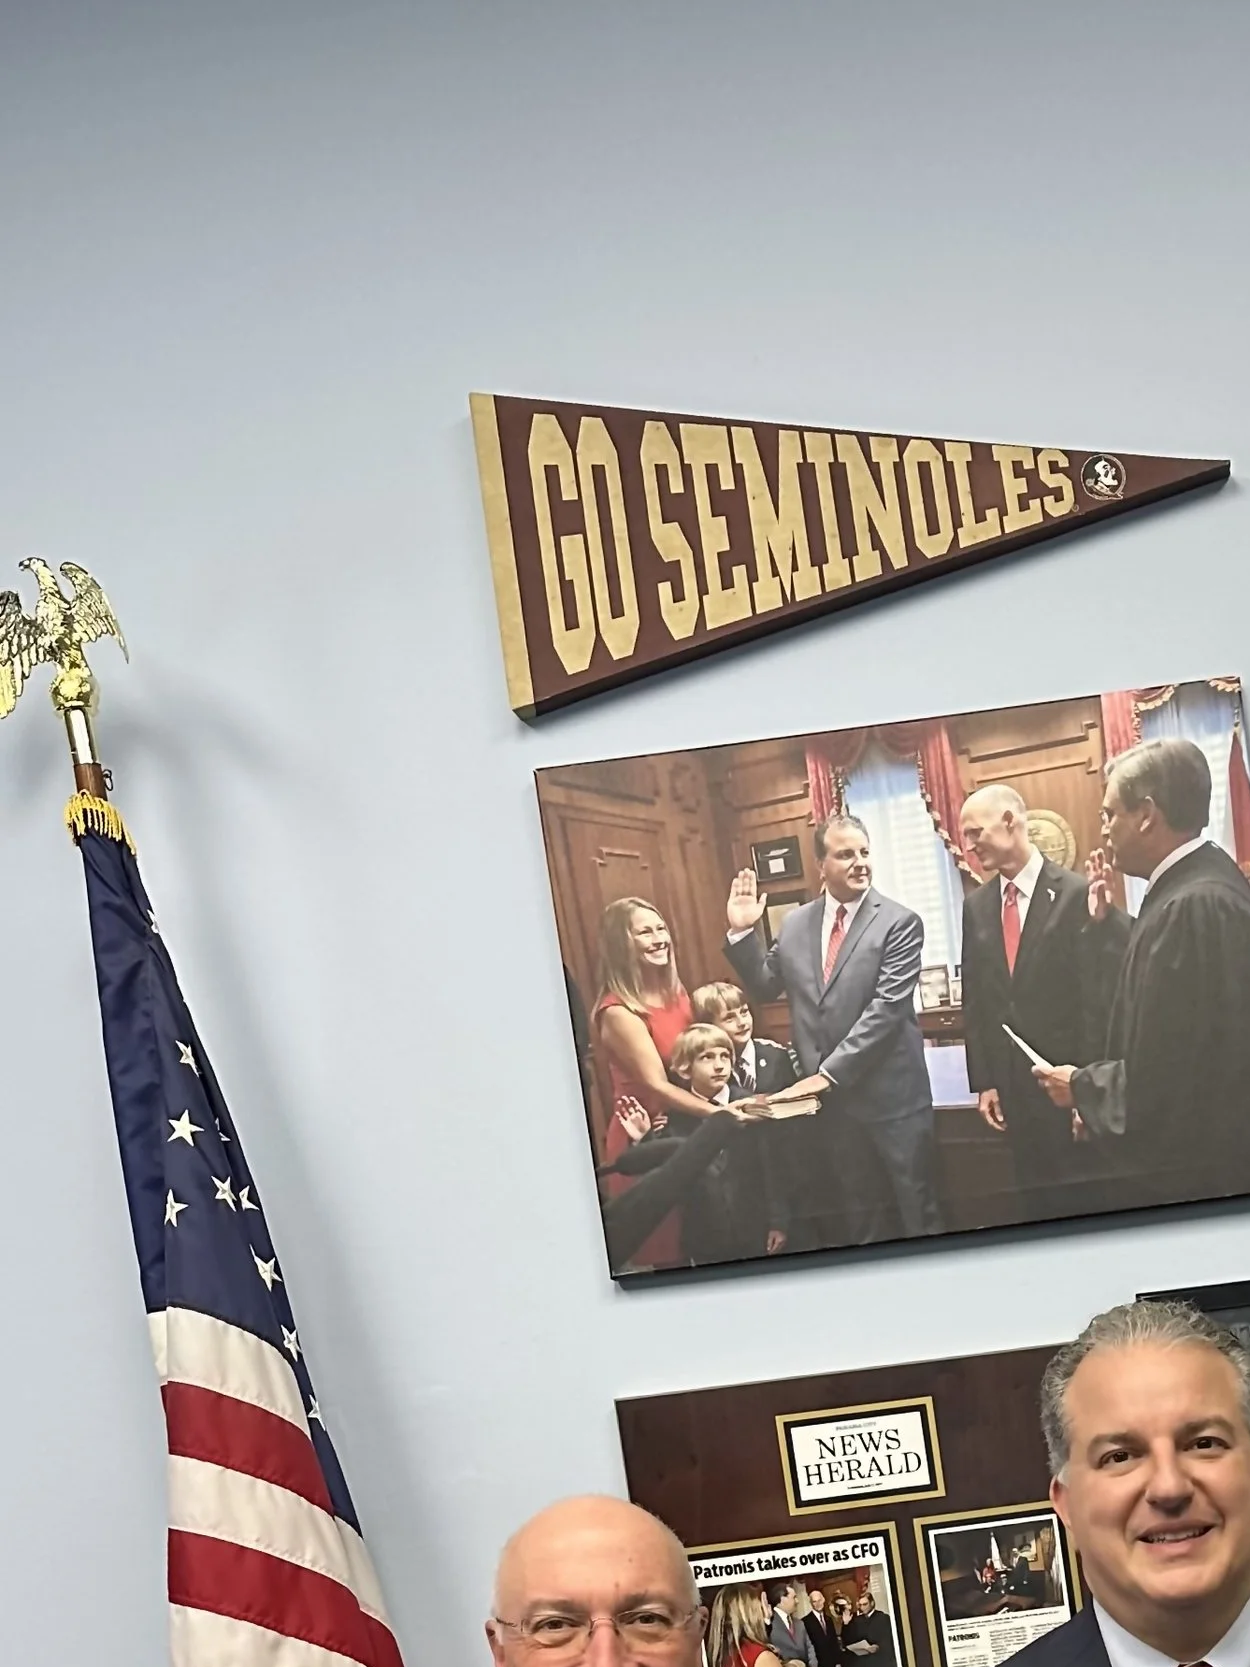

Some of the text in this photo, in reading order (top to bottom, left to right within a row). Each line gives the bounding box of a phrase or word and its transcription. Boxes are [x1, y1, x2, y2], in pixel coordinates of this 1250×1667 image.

[528, 413, 1075, 676] GO SEMINOLES
[815, 1428, 901, 1459] NEWS
[803, 1451, 922, 1486] HERALD
[693, 1542, 880, 1579] Patronis takes over as CFO
